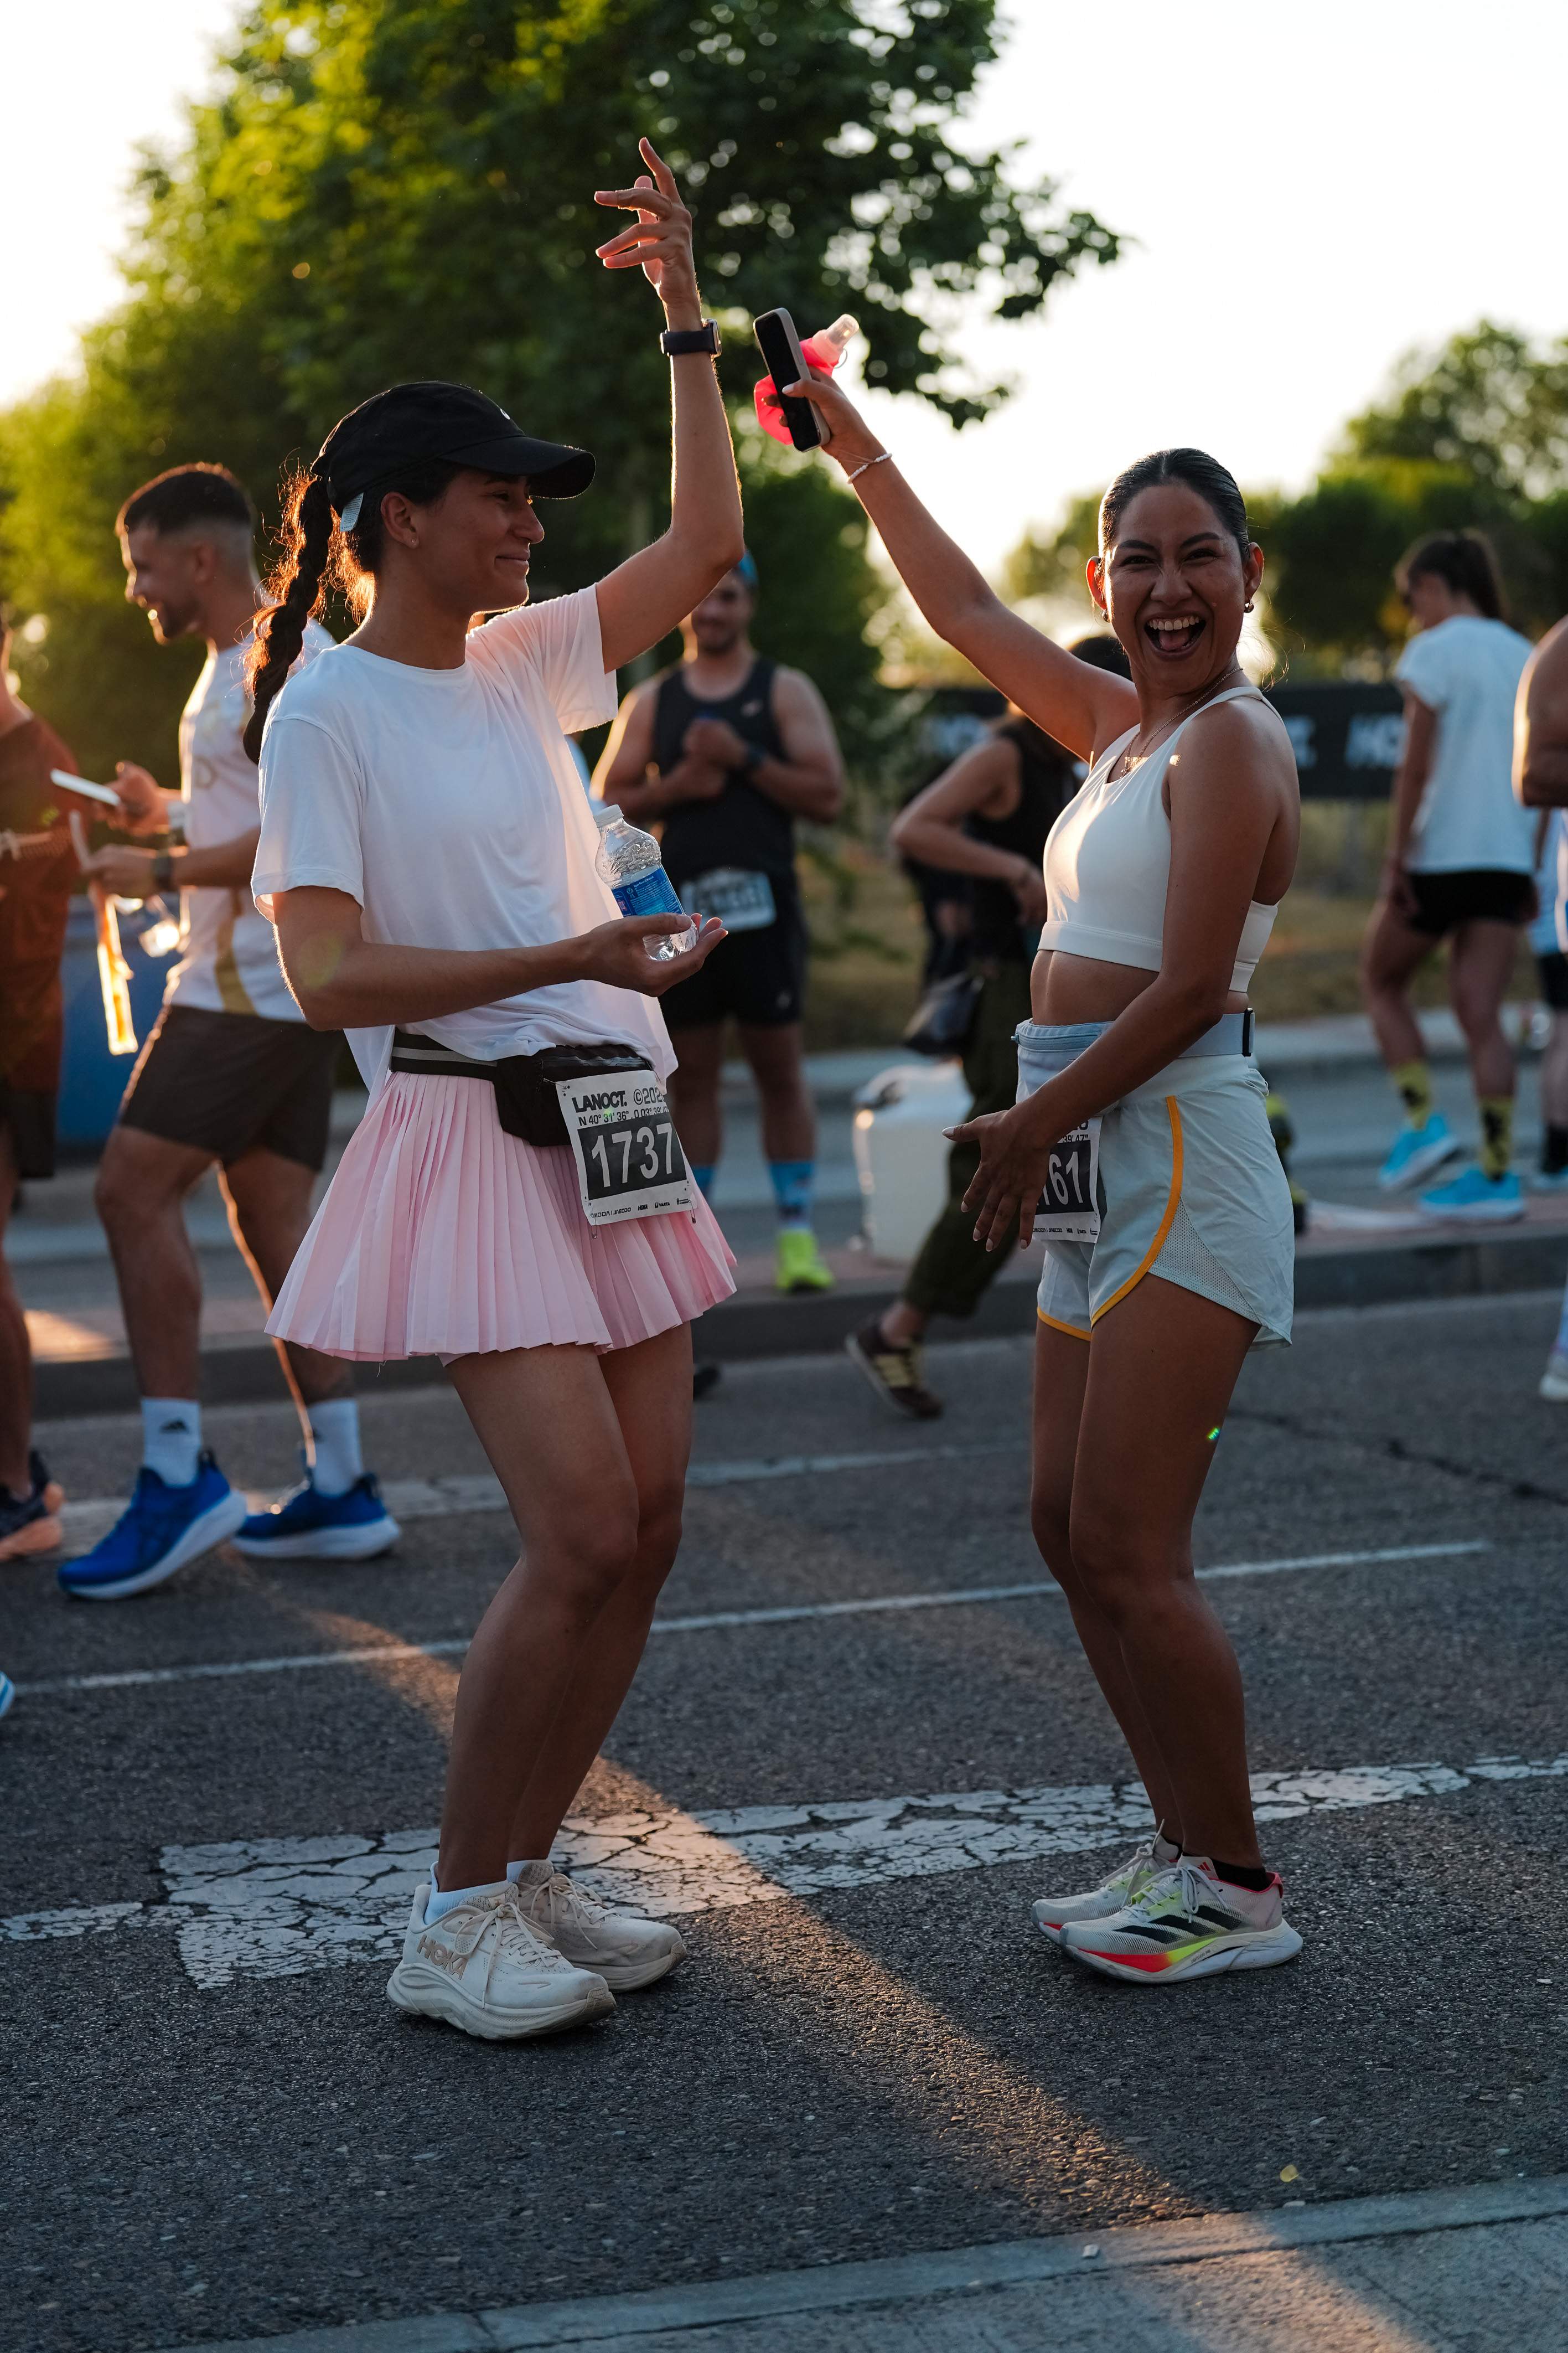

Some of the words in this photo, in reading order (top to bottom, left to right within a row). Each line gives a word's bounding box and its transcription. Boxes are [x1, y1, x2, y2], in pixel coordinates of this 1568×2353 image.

[571, 1090, 628, 1113] LANOCT.
[578, 1117, 587, 1126] N
[591, 1122, 673, 1188] 1737
[613, 1207, 632, 1215] JAECOO
[417, 1934, 469, 1980] HOKA
